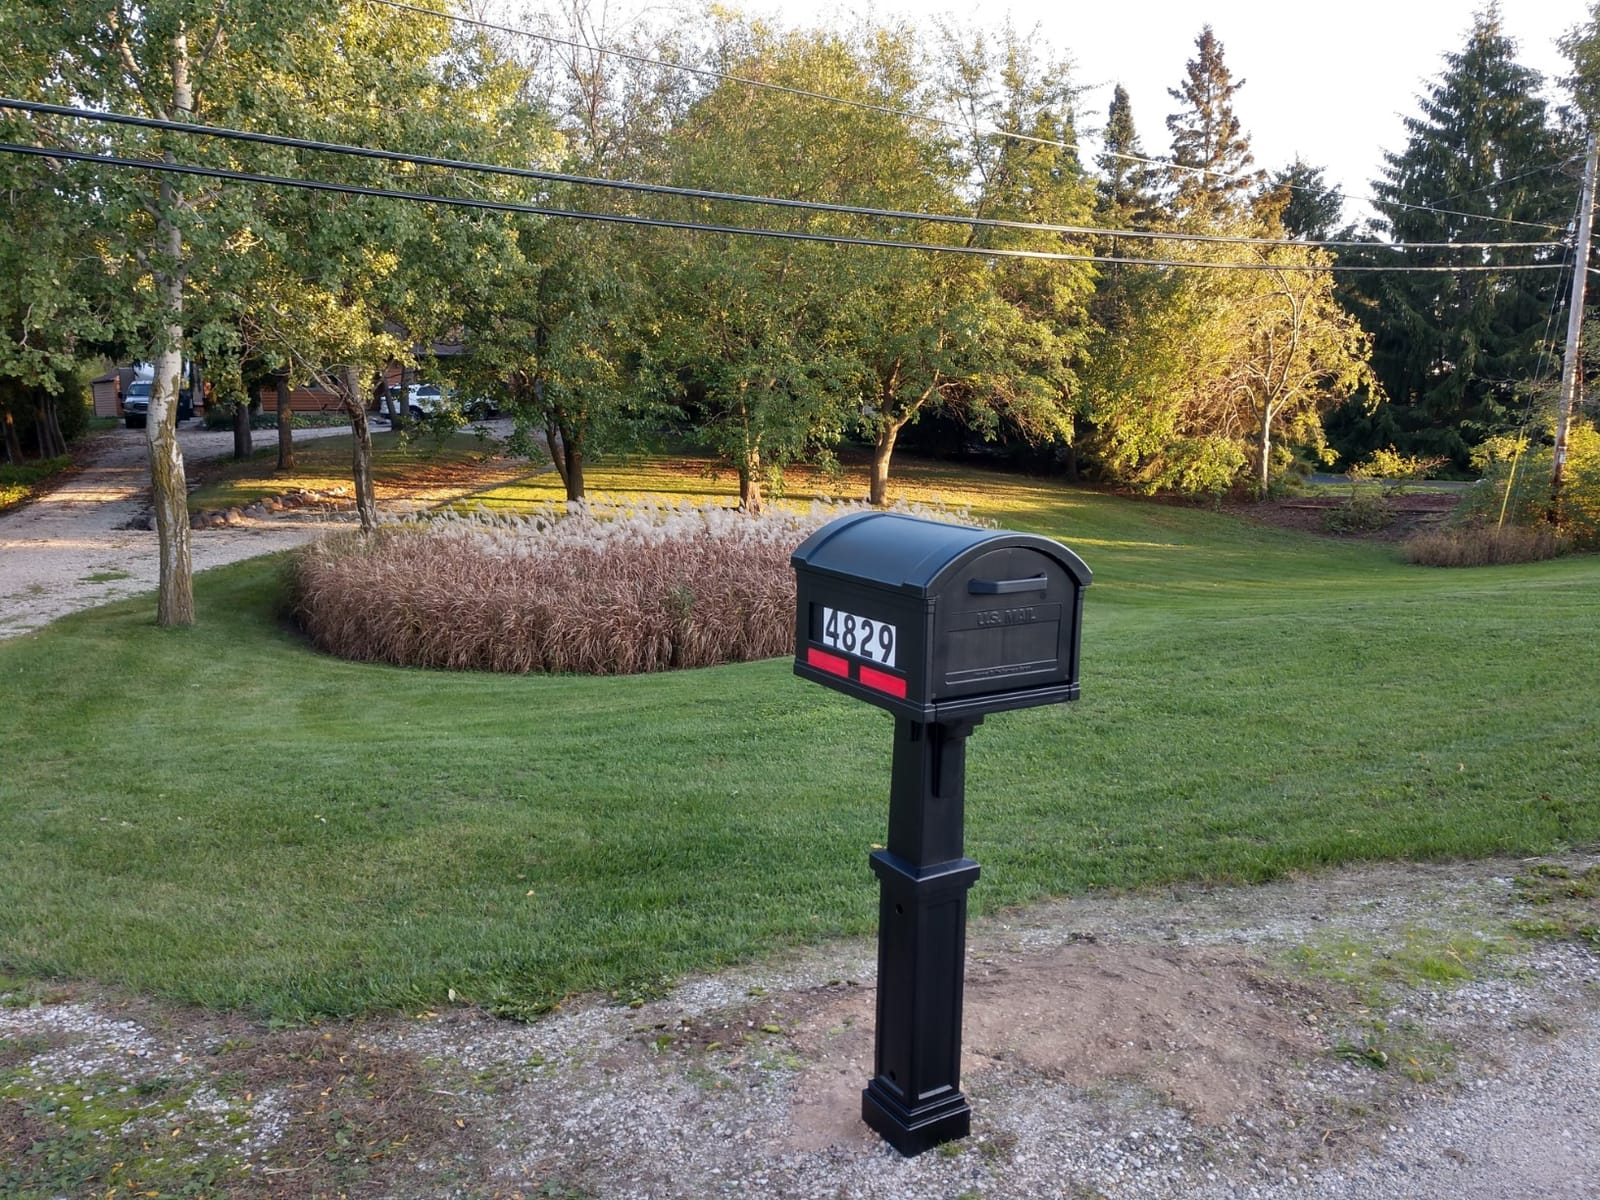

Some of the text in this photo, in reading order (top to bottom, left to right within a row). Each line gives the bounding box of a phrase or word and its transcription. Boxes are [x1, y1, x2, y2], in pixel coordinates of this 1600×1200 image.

[977, 606, 1037, 626] U.S. MAIL
[825, 609, 893, 663] 4829
